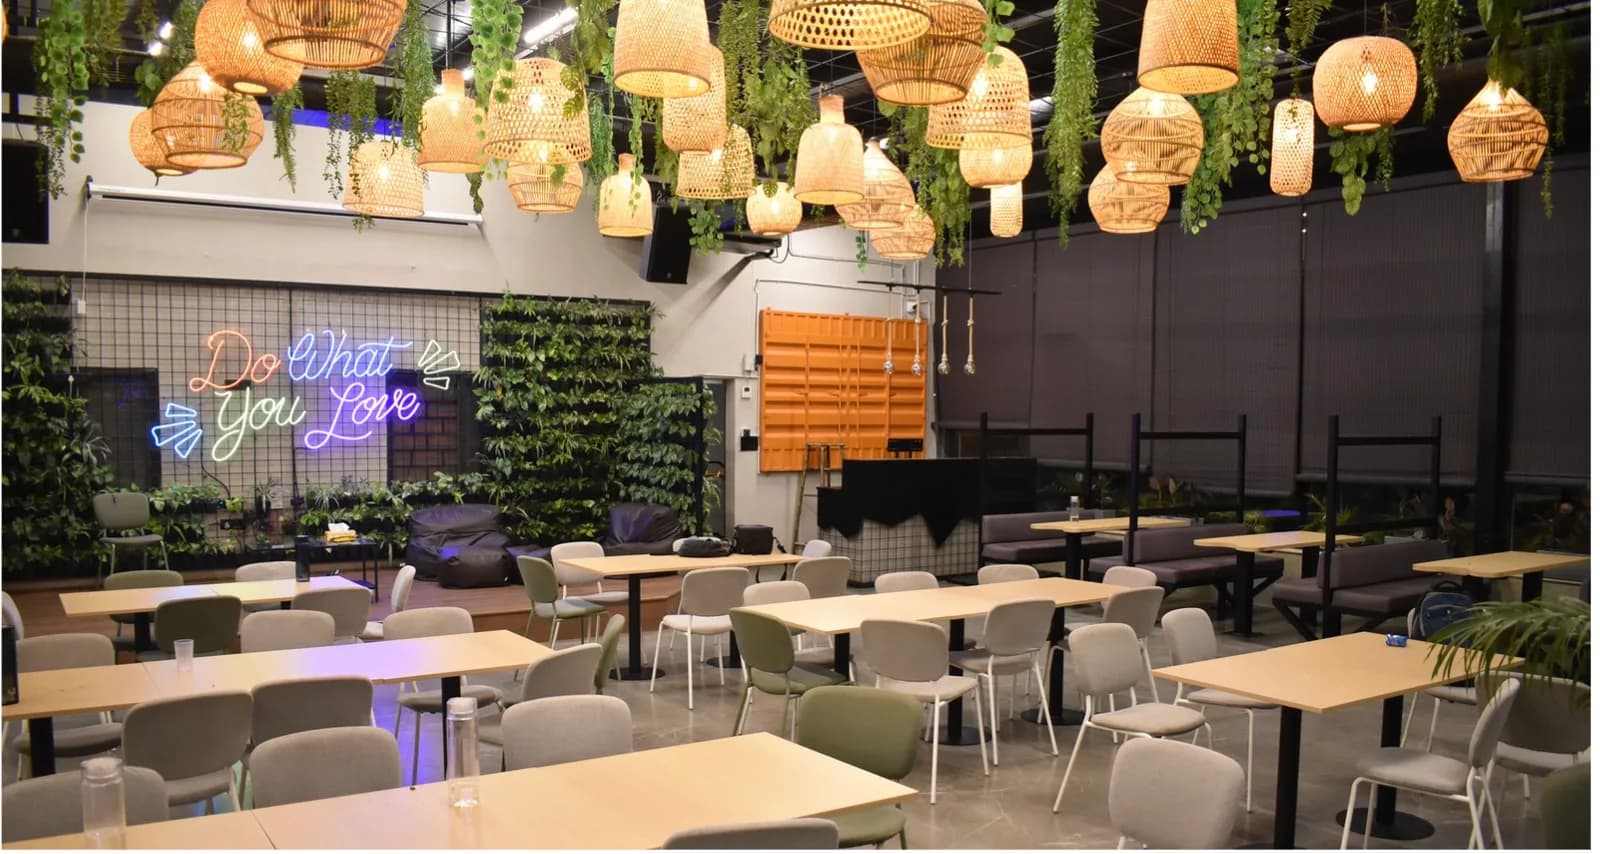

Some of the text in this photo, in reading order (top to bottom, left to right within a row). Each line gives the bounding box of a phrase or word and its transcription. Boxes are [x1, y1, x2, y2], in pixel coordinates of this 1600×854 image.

[189, 329, 413, 392] Do What
[212, 382, 420, 461] You Love
